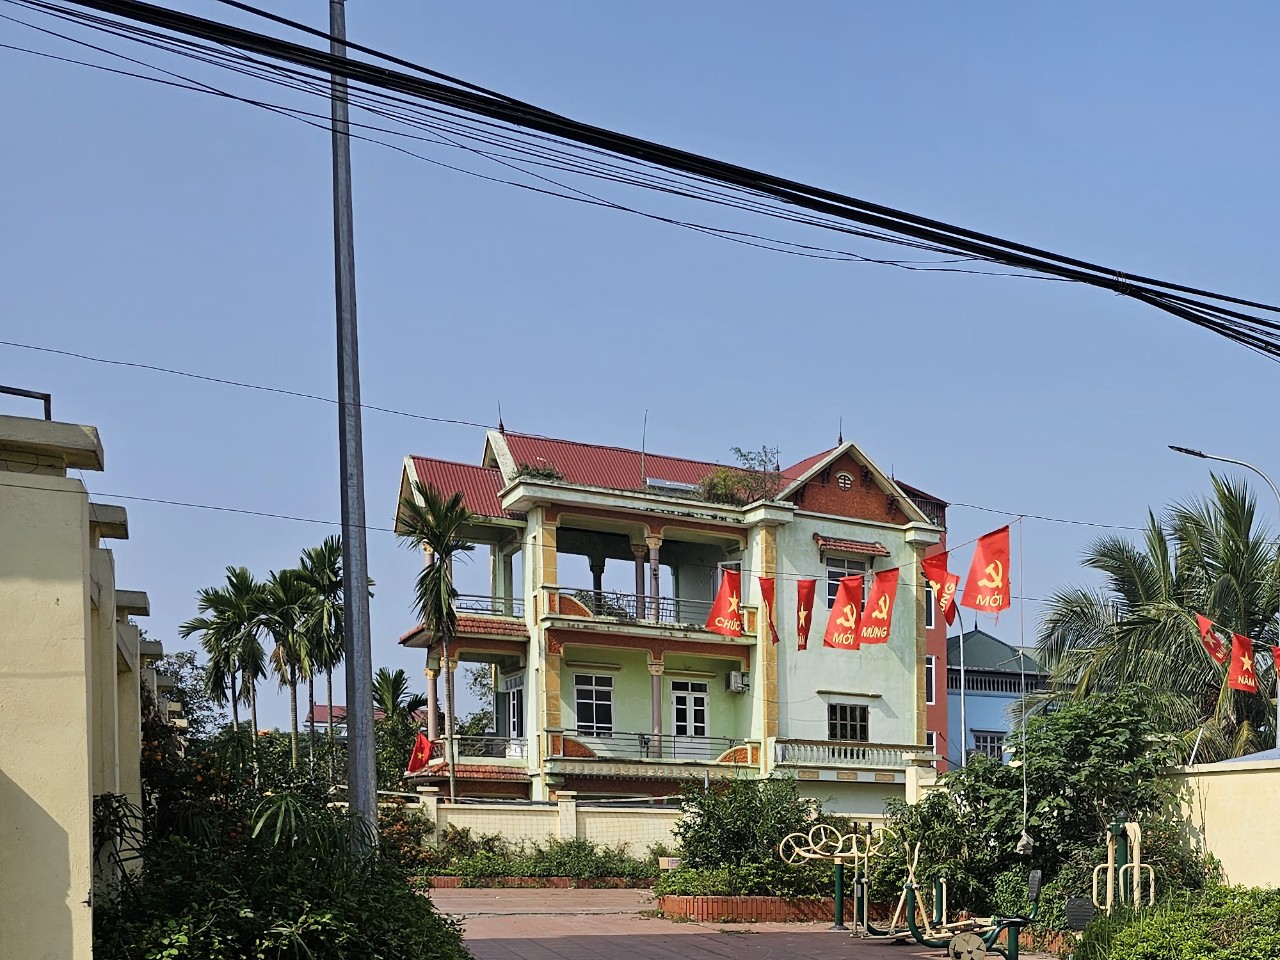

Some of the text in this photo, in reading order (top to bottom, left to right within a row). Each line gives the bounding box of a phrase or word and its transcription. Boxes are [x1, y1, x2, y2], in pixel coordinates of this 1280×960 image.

[975, 590, 1003, 607] MỚI
[715, 616, 741, 631] CHÚC
[832, 630, 855, 645] MỚI
[860, 625, 887, 639] MỪNG
[1237, 674, 1256, 688] NĂM
